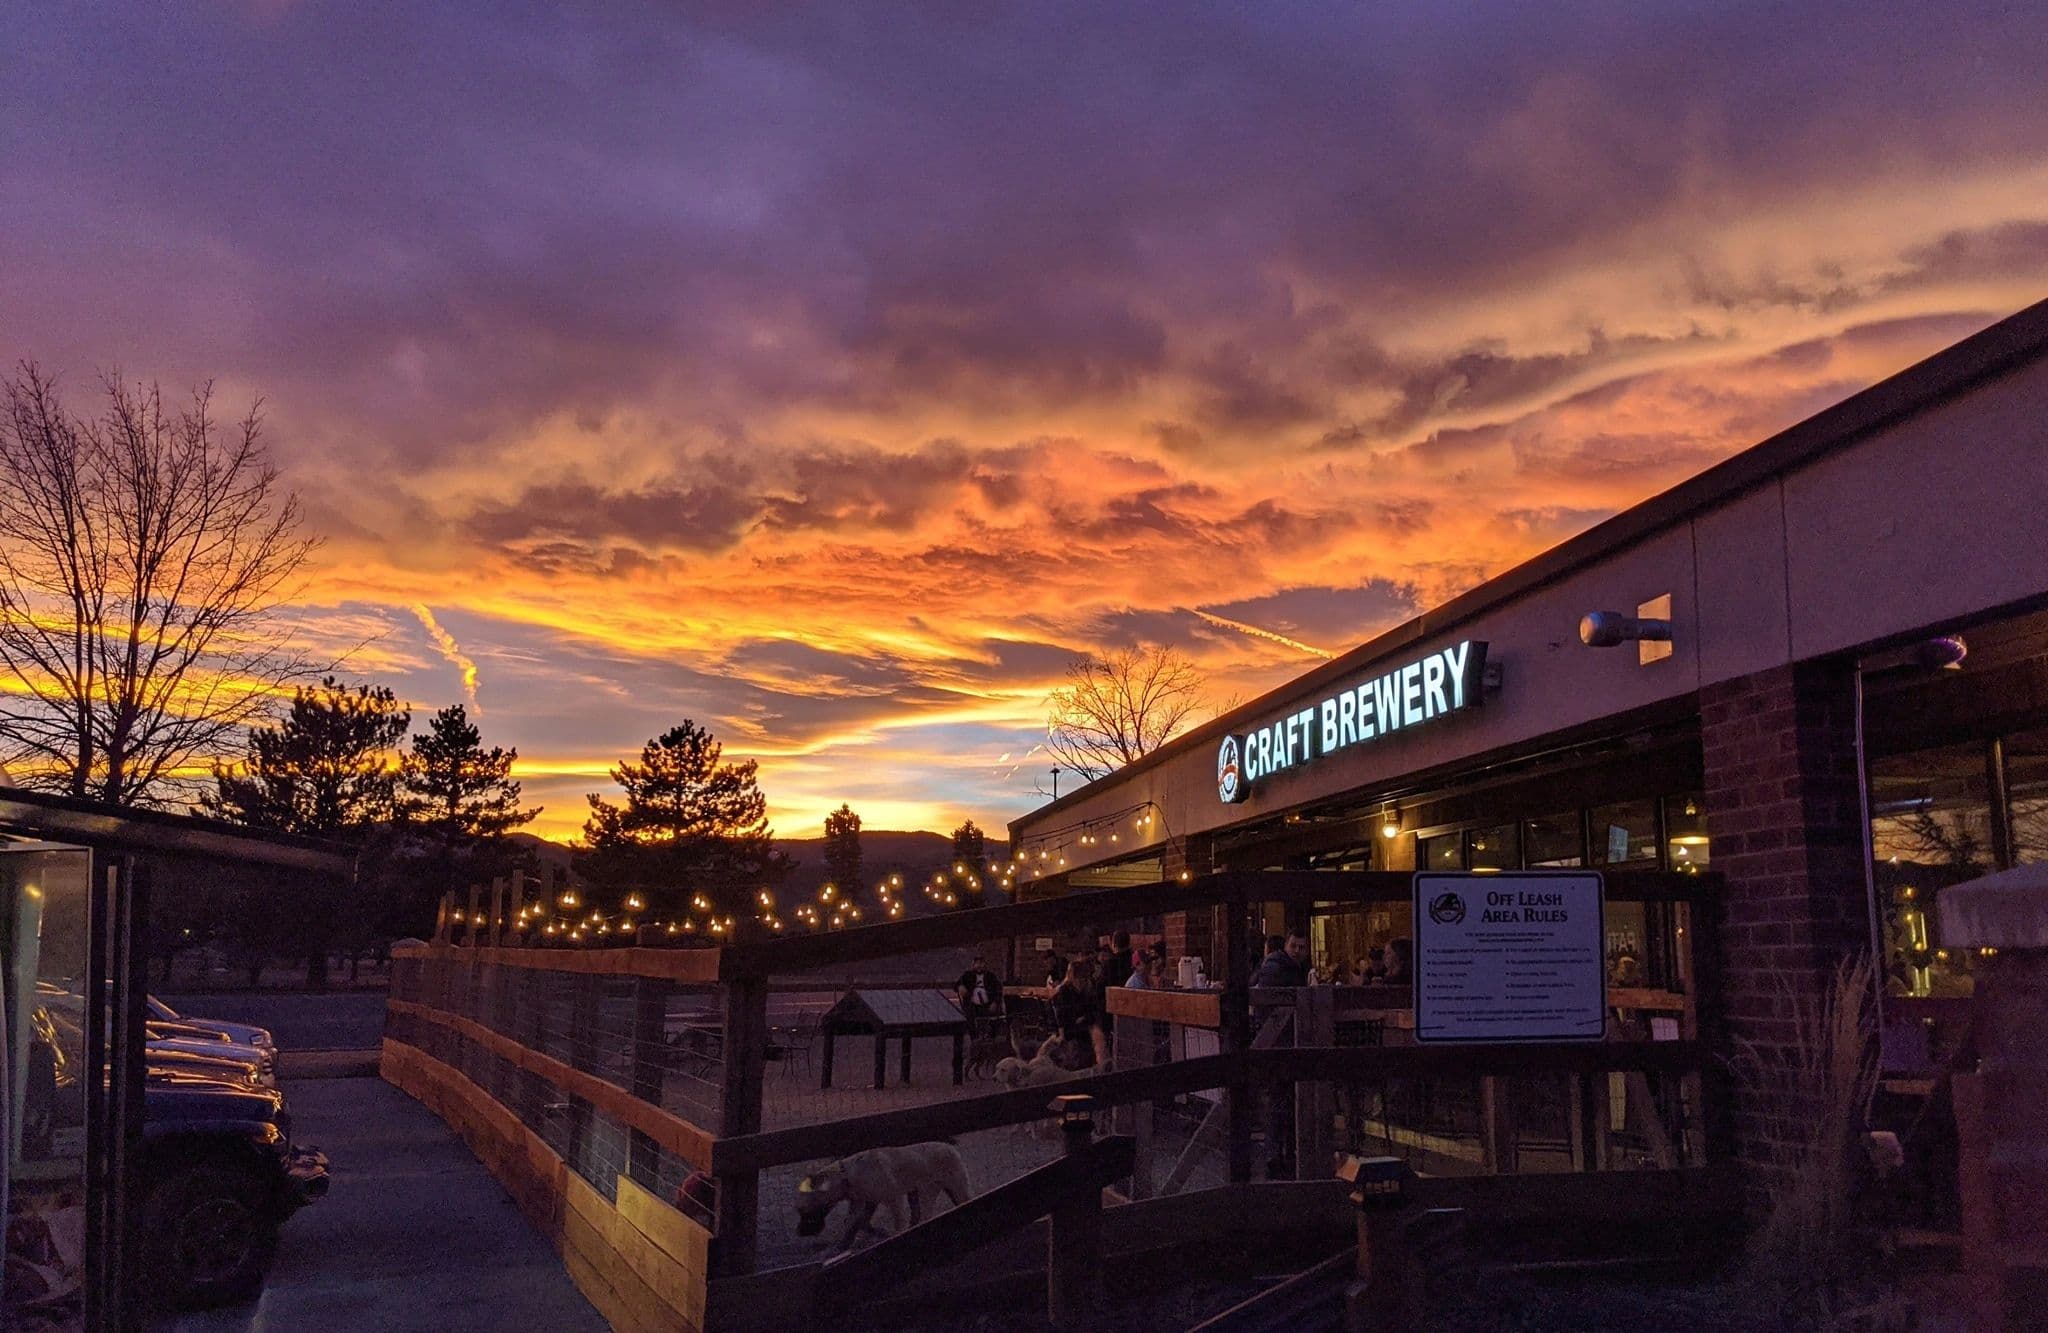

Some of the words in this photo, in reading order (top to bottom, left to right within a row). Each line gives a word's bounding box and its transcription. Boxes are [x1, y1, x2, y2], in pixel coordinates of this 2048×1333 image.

[1244, 707, 1314, 781] CRAFT
[1321, 640, 1470, 753] BREWERY
[1487, 891, 1514, 906] OFF
[1518, 891, 1562, 906] LEASH
[1481, 908, 1520, 922] AREA
[1524, 908, 1568, 922] RULES
